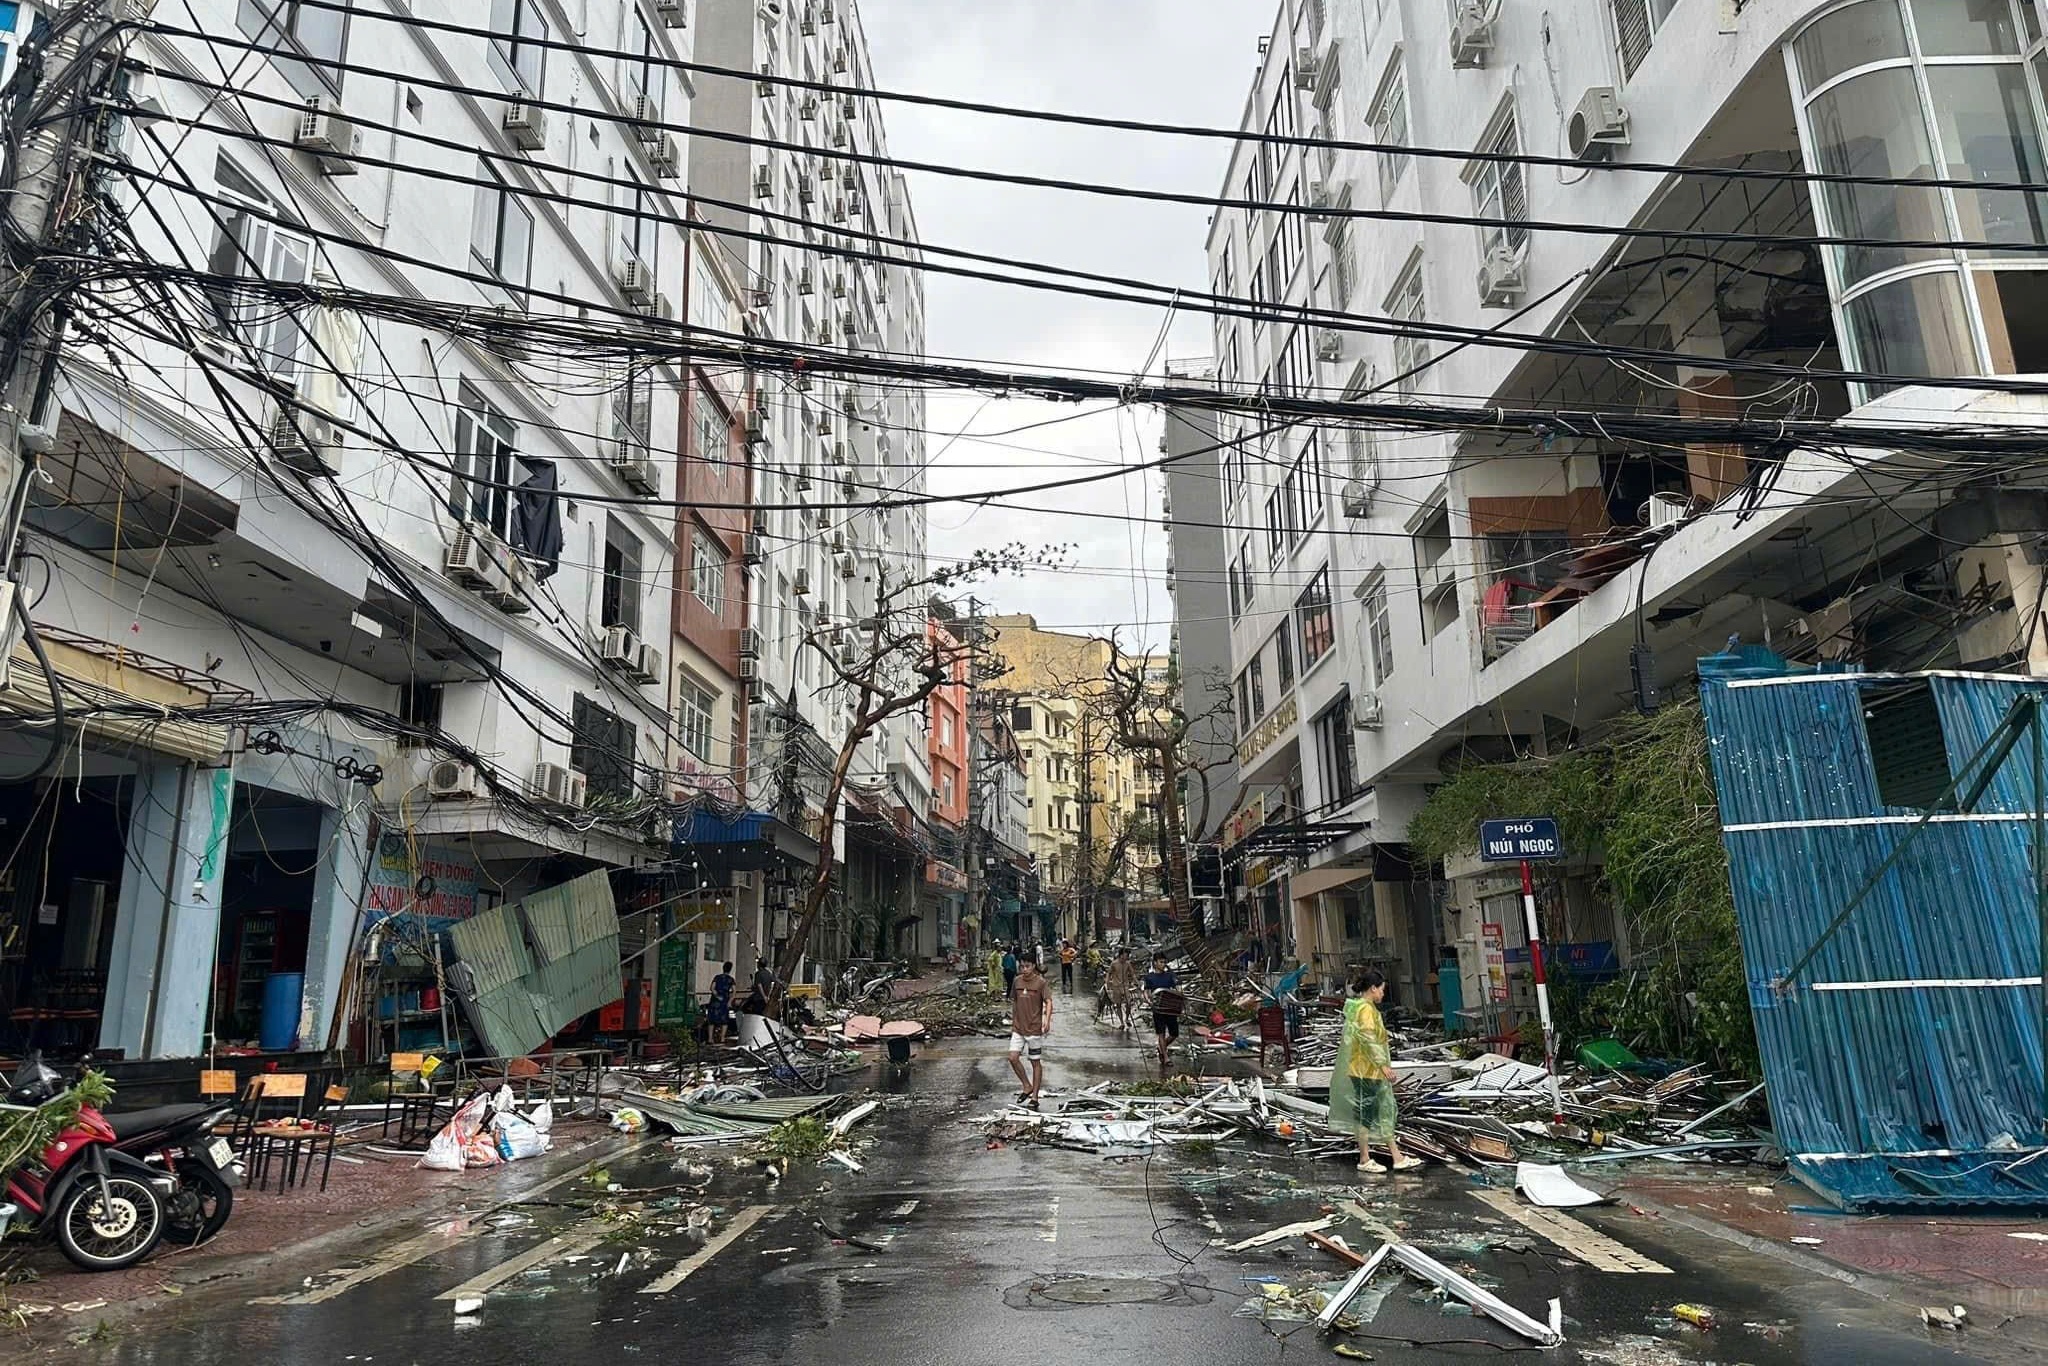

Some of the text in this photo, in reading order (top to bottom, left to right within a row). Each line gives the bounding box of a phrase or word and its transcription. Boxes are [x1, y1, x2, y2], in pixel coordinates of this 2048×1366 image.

[1504, 820, 1534, 834] PHỐ
[1489, 838, 1554, 855] NÚI NGỌC
